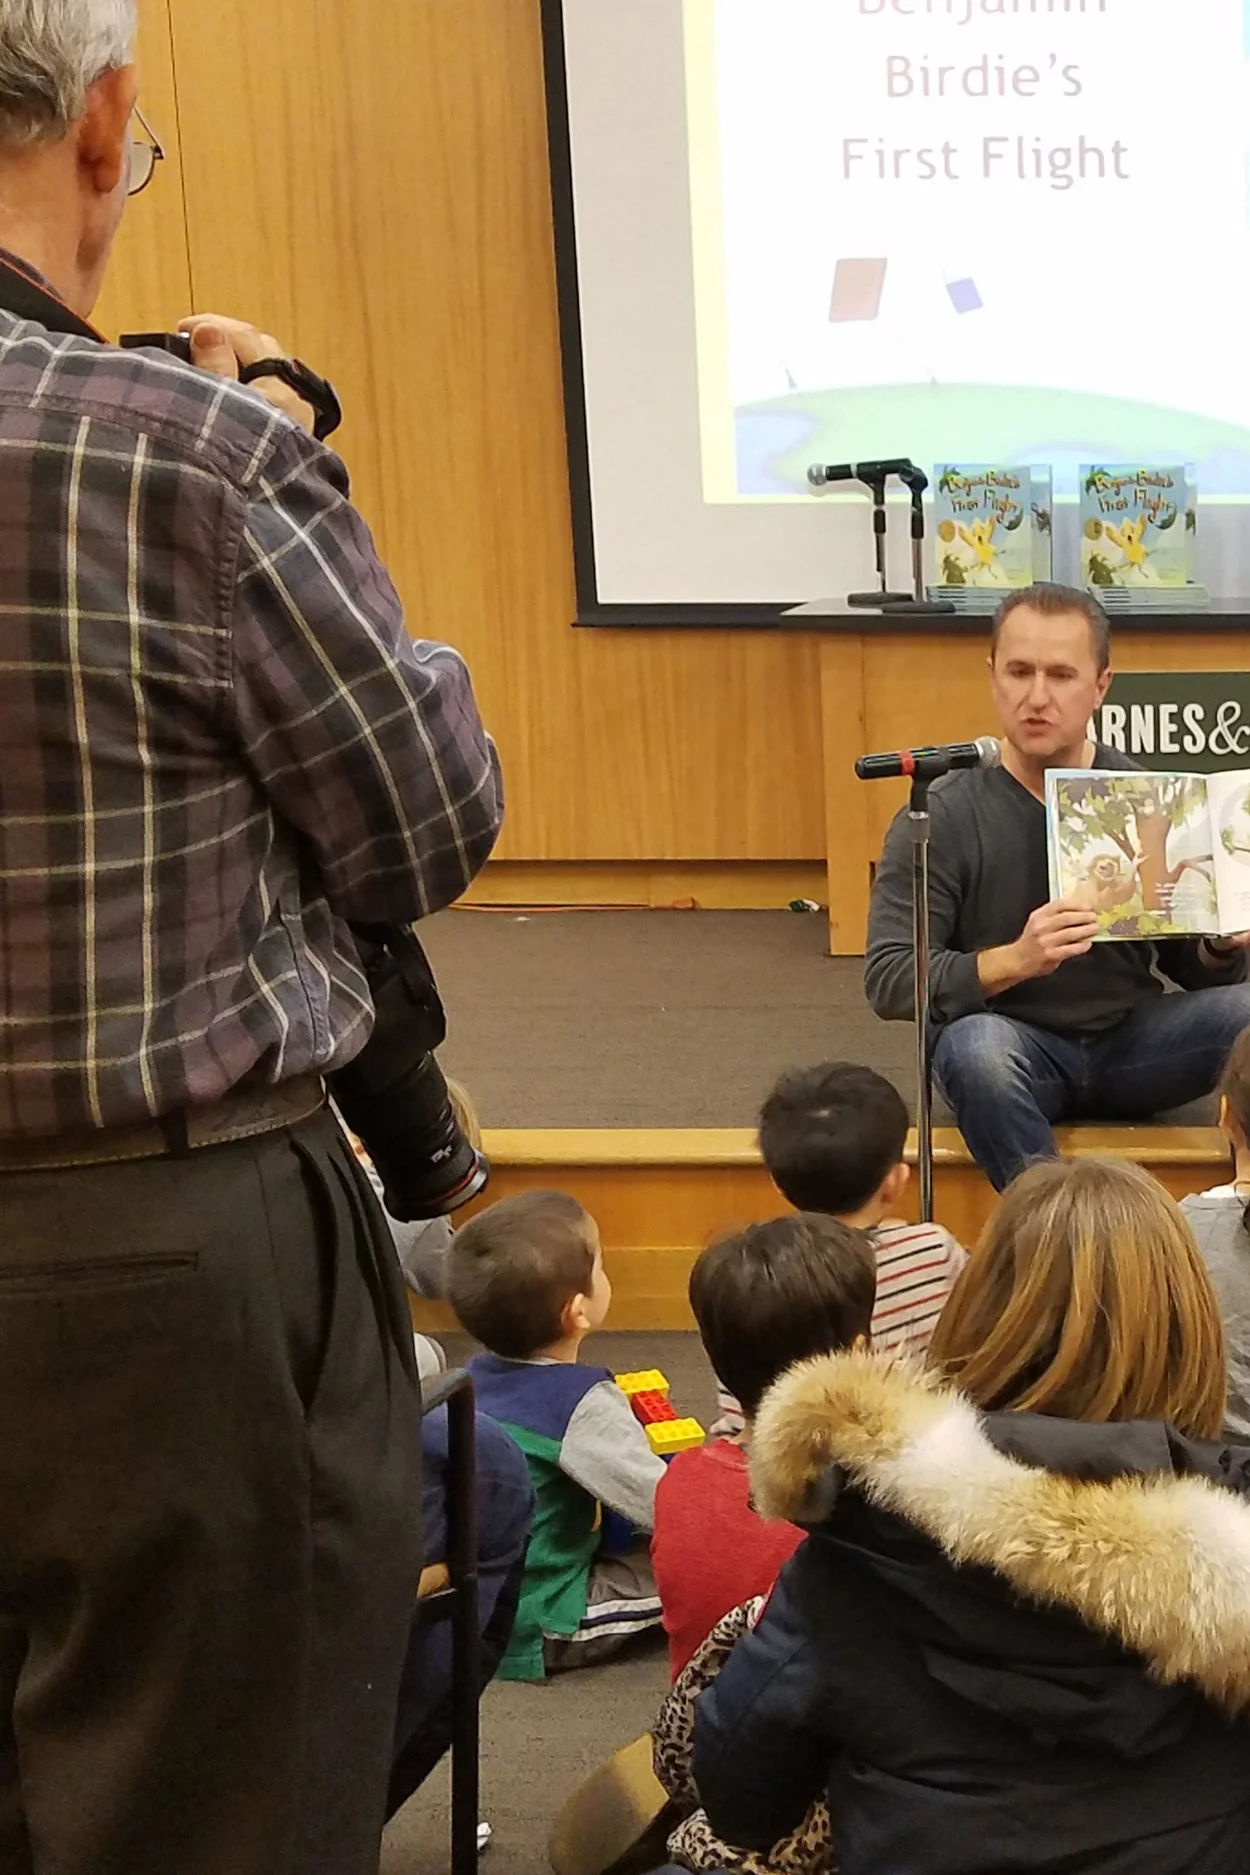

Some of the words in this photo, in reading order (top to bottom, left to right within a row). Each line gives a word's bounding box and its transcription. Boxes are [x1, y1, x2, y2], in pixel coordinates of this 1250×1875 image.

[886, 53, 1082, 97] Birdie’s
[842, 138, 959, 179] First
[983, 135, 1129, 190] Flight
